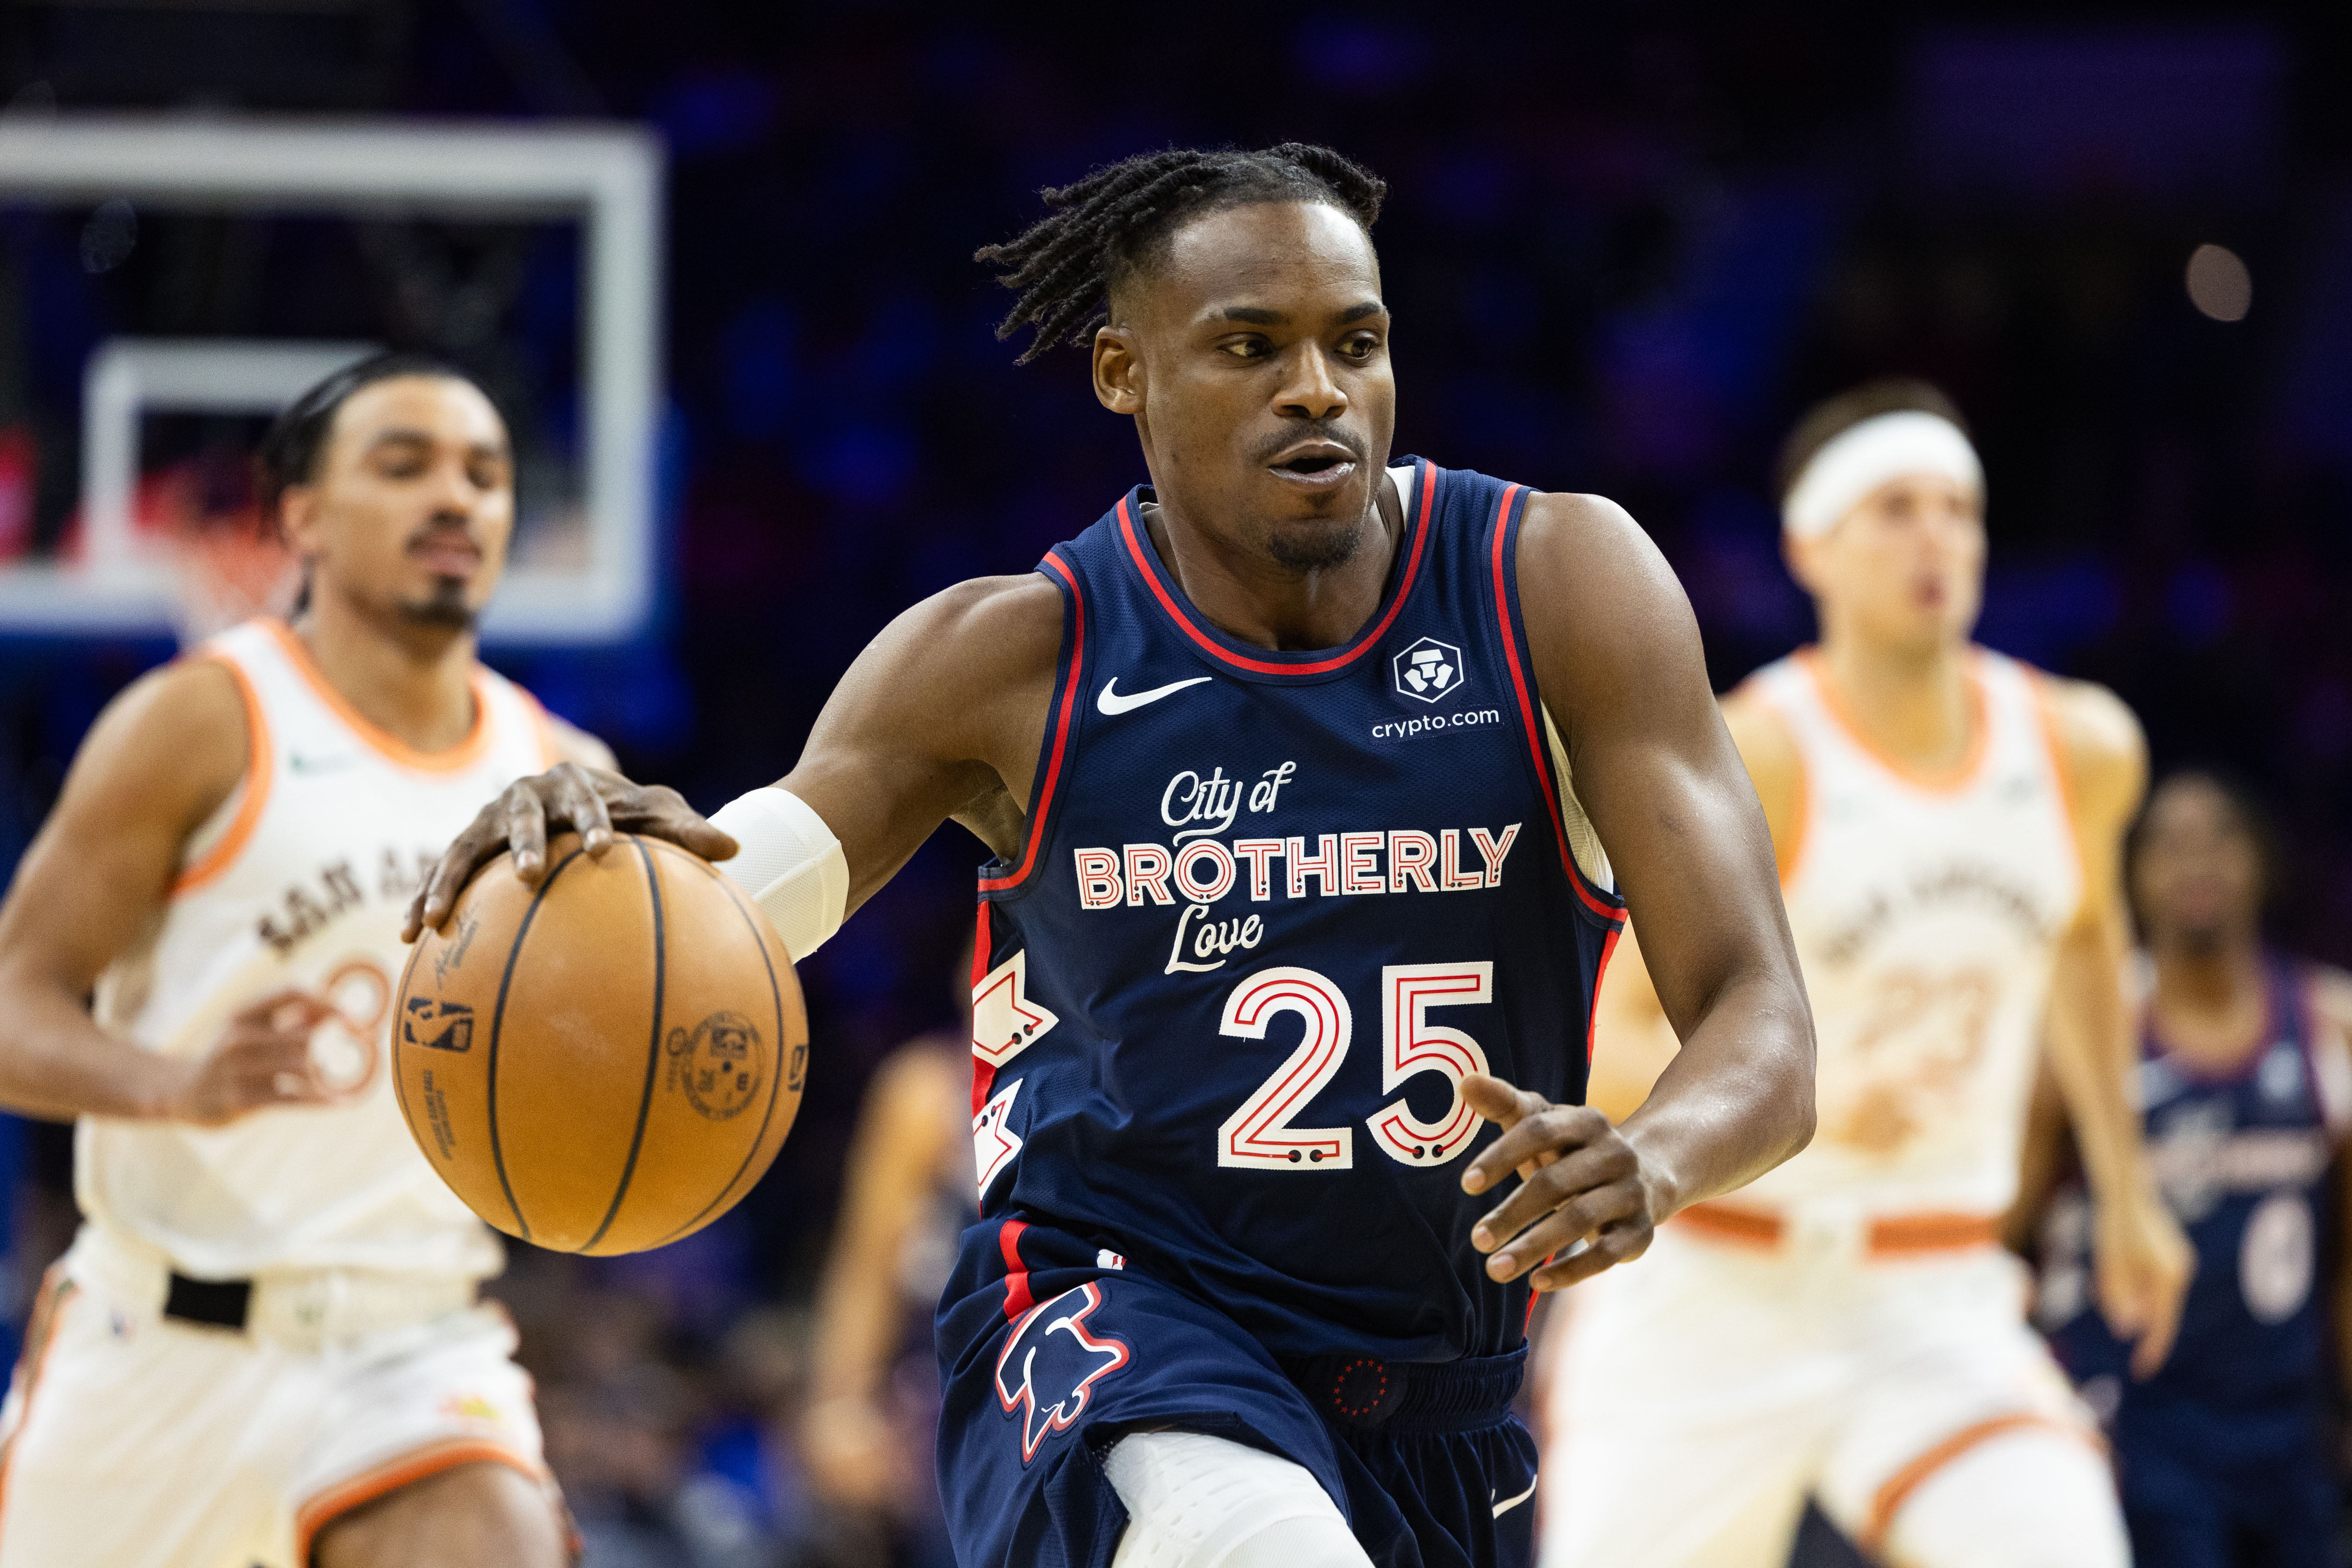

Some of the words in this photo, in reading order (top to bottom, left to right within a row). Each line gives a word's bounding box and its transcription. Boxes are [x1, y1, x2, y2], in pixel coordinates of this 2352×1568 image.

[1372, 710, 1499, 738] crypto.com
[1161, 767, 1242, 846] City
[1249, 761, 1297, 813] of
[1074, 823, 1522, 910] BROTHERLY
[1165, 906, 1264, 974] Love
[1218, 961, 1493, 1170] 25
